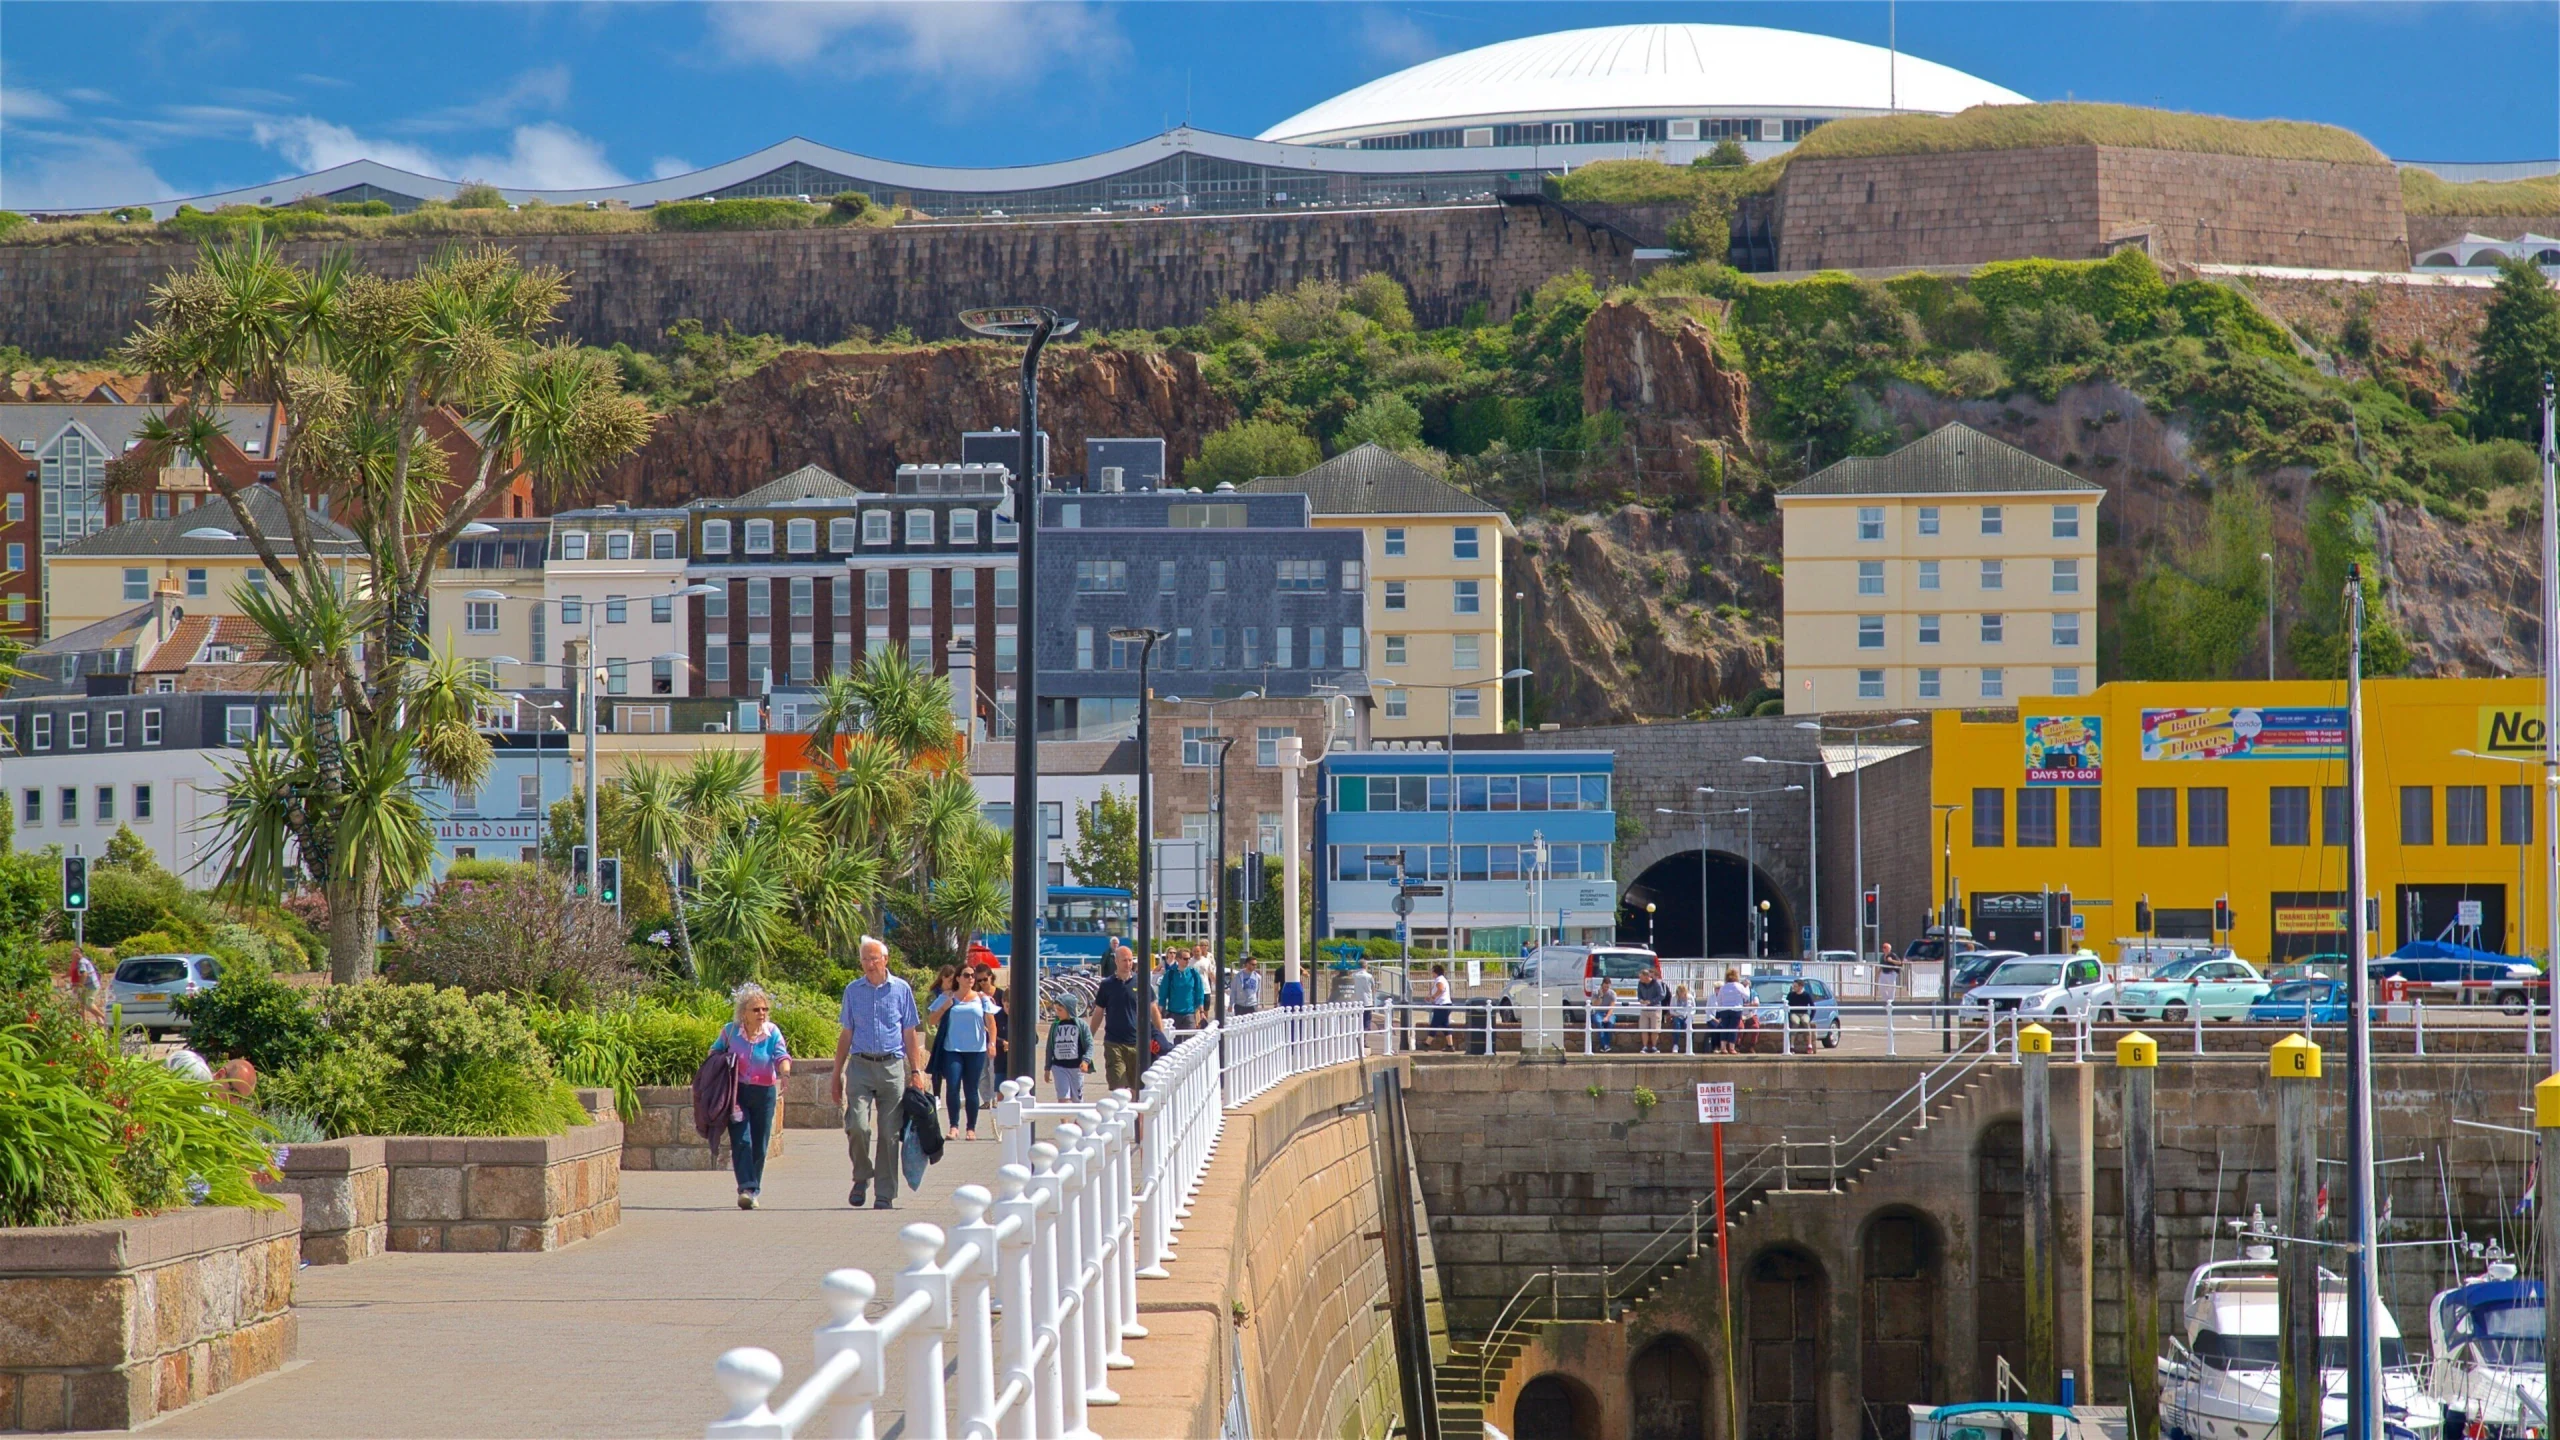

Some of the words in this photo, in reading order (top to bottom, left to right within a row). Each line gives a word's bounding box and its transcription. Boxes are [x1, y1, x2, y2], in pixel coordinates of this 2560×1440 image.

[2153, 712, 2177, 722] Jersey
[2171, 717, 2210, 732] Battle
[2487, 712, 2547, 750] No
[2171, 736, 2227, 754] Flowers
[2031, 771, 2058, 779] DAYS
[2060, 771, 2075, 779] TO
[2077, 771, 2097, 779] GO!
[427, 822, 532, 837] oubadour
[2073, 916, 2082, 927] P
[1055, 1026, 1076, 1036] NYC
[2033, 1039, 2040, 1050] G
[2133, 1048, 2142, 1061] G
[2294, 1053, 2305, 1071] G
